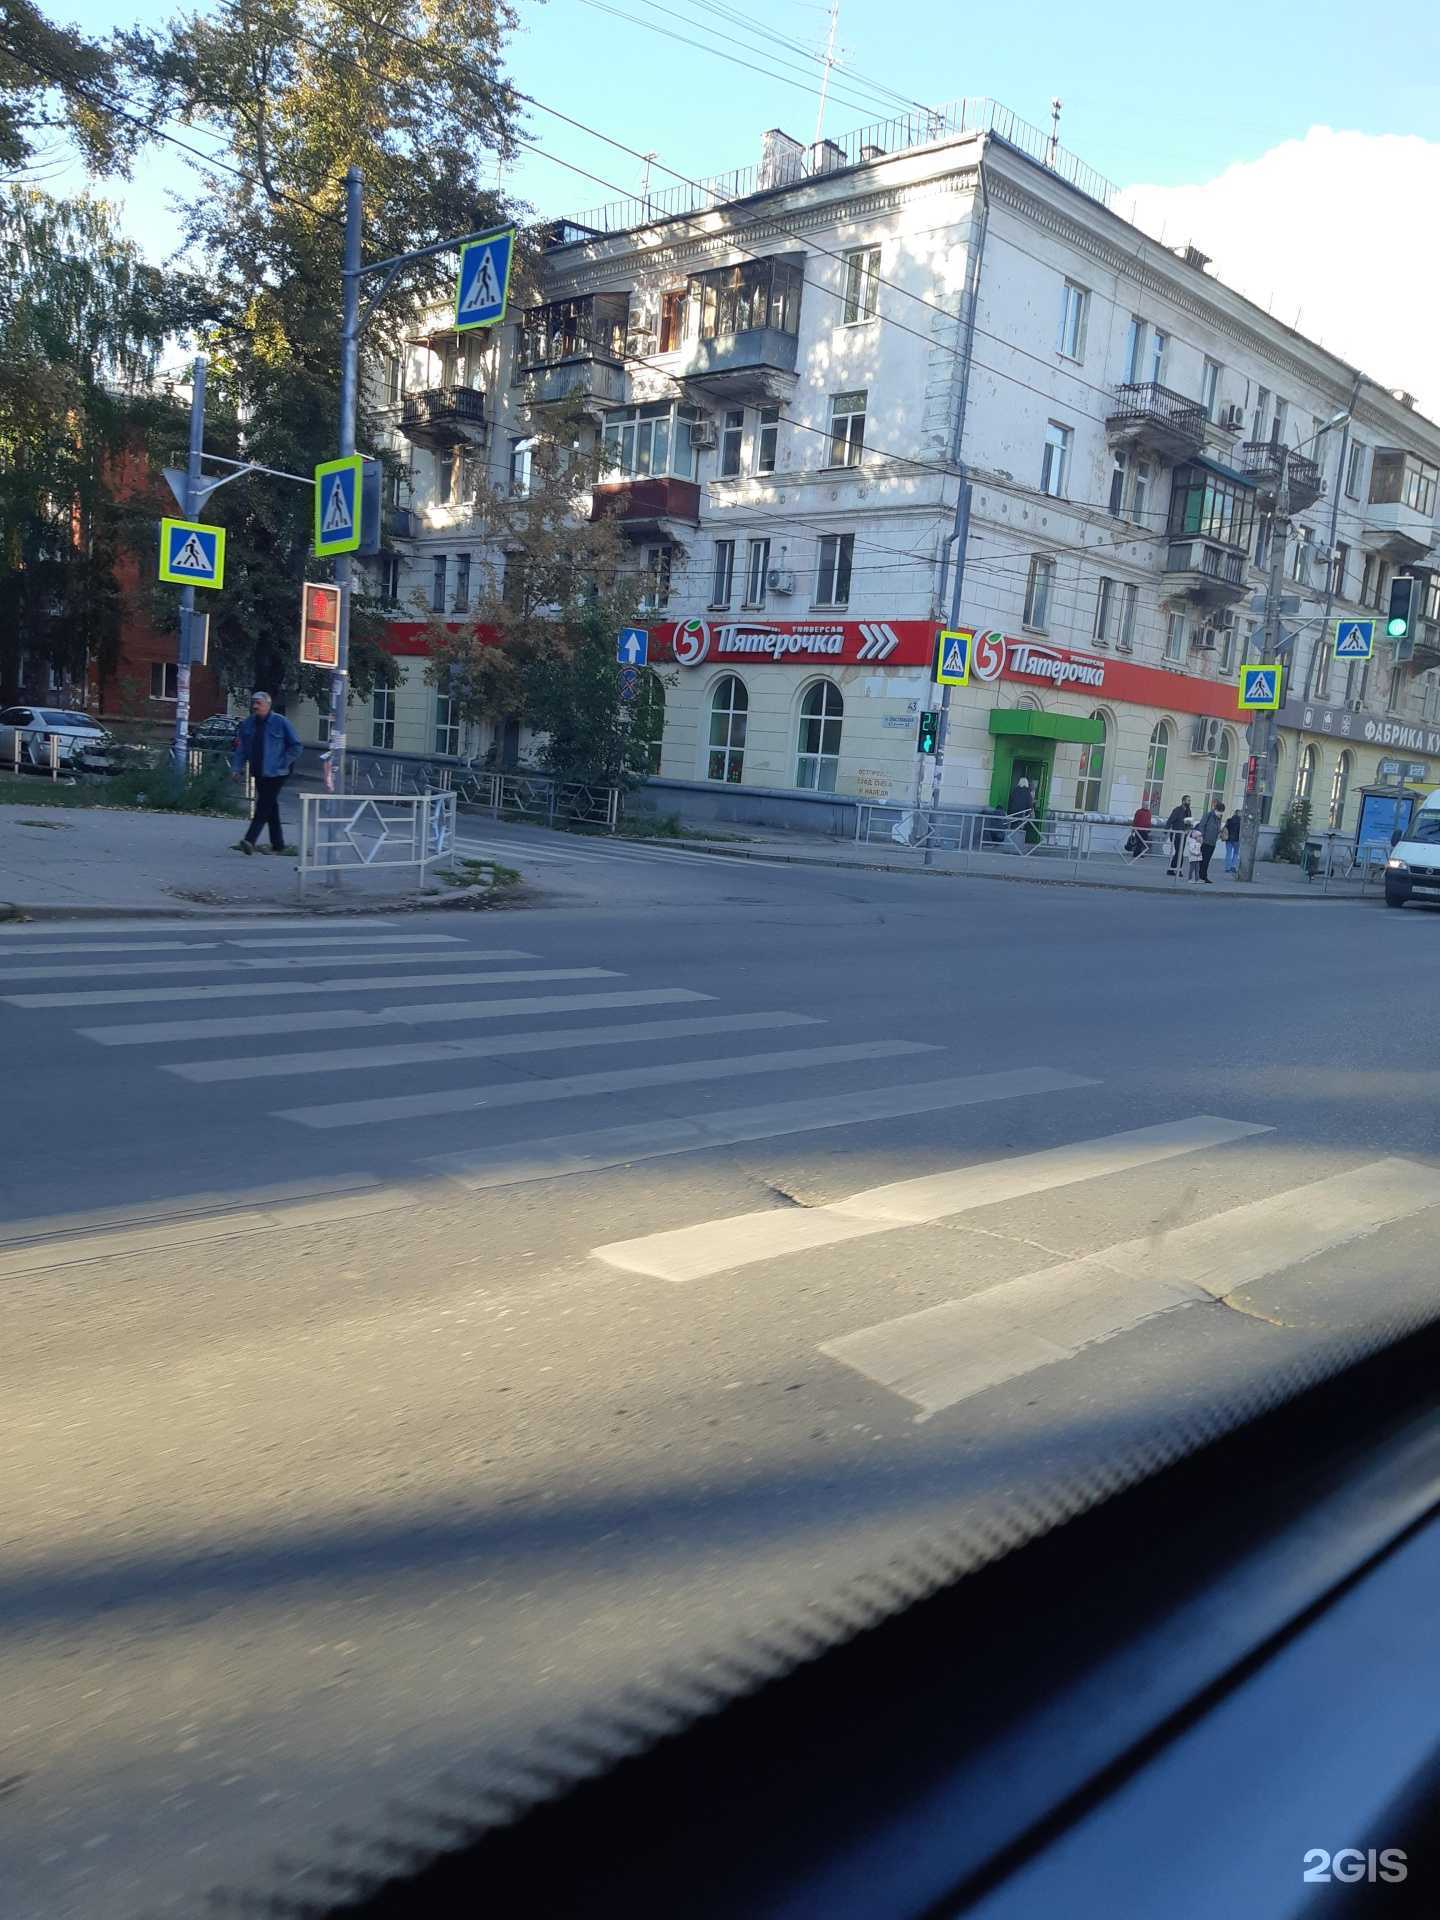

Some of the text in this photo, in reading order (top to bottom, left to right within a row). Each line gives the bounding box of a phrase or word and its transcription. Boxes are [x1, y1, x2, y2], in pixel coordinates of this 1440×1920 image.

[713, 624, 846, 660] Пятерочка
[1008, 643, 1105, 686] Пятерочка
[1364, 720, 1423, 750] ФАБРИКА
